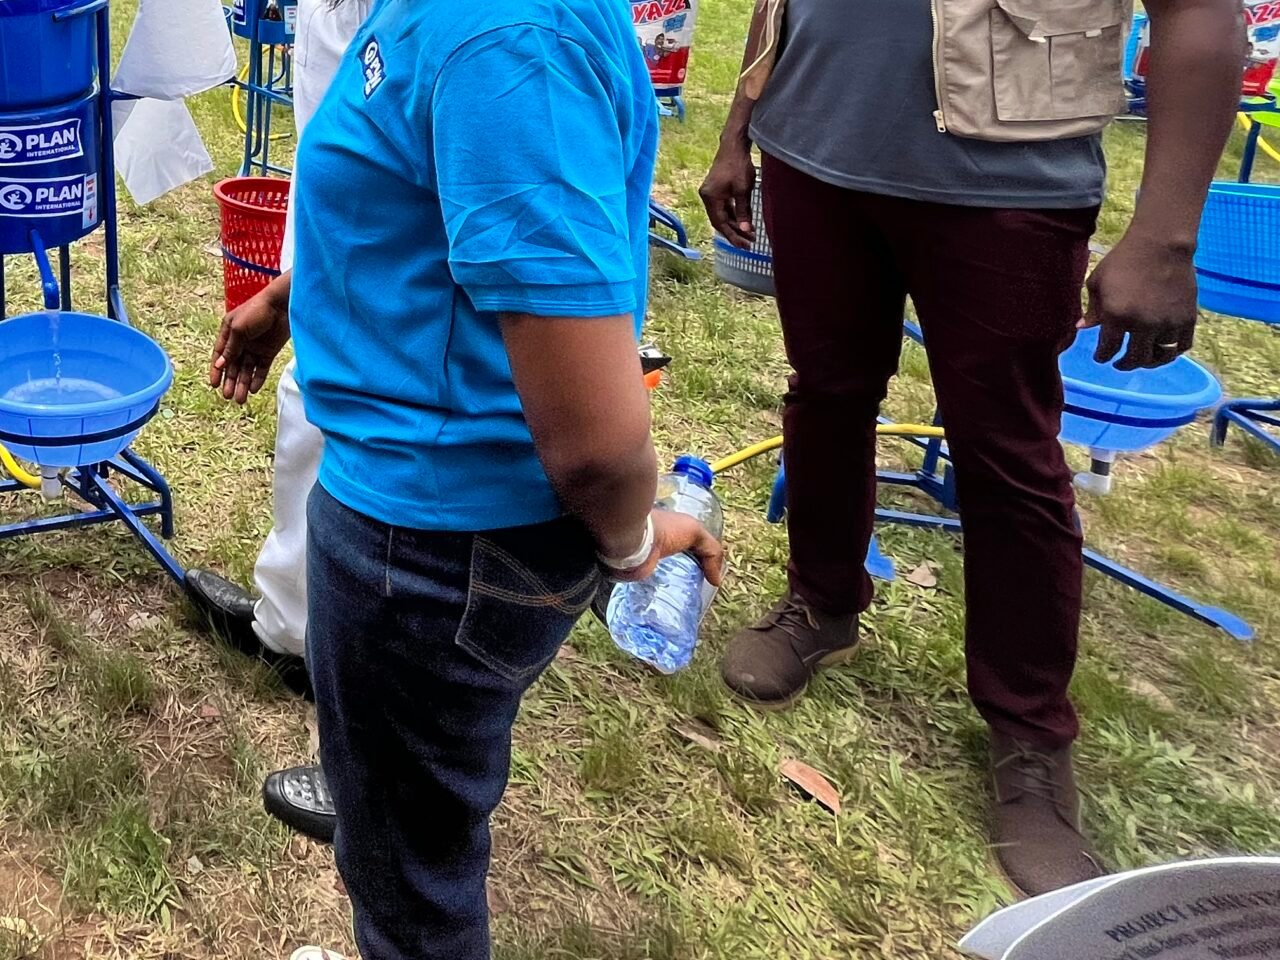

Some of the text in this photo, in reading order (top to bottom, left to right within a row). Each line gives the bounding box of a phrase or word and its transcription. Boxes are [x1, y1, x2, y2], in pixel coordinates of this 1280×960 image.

[25, 127, 75, 150] PLAN
[26, 144, 76, 158] INTERNATIONAL
[35, 183, 83, 203] PLAN
[35, 200, 82, 211] INTERNATIONAL
[1105, 903, 1189, 943] PROJECT
